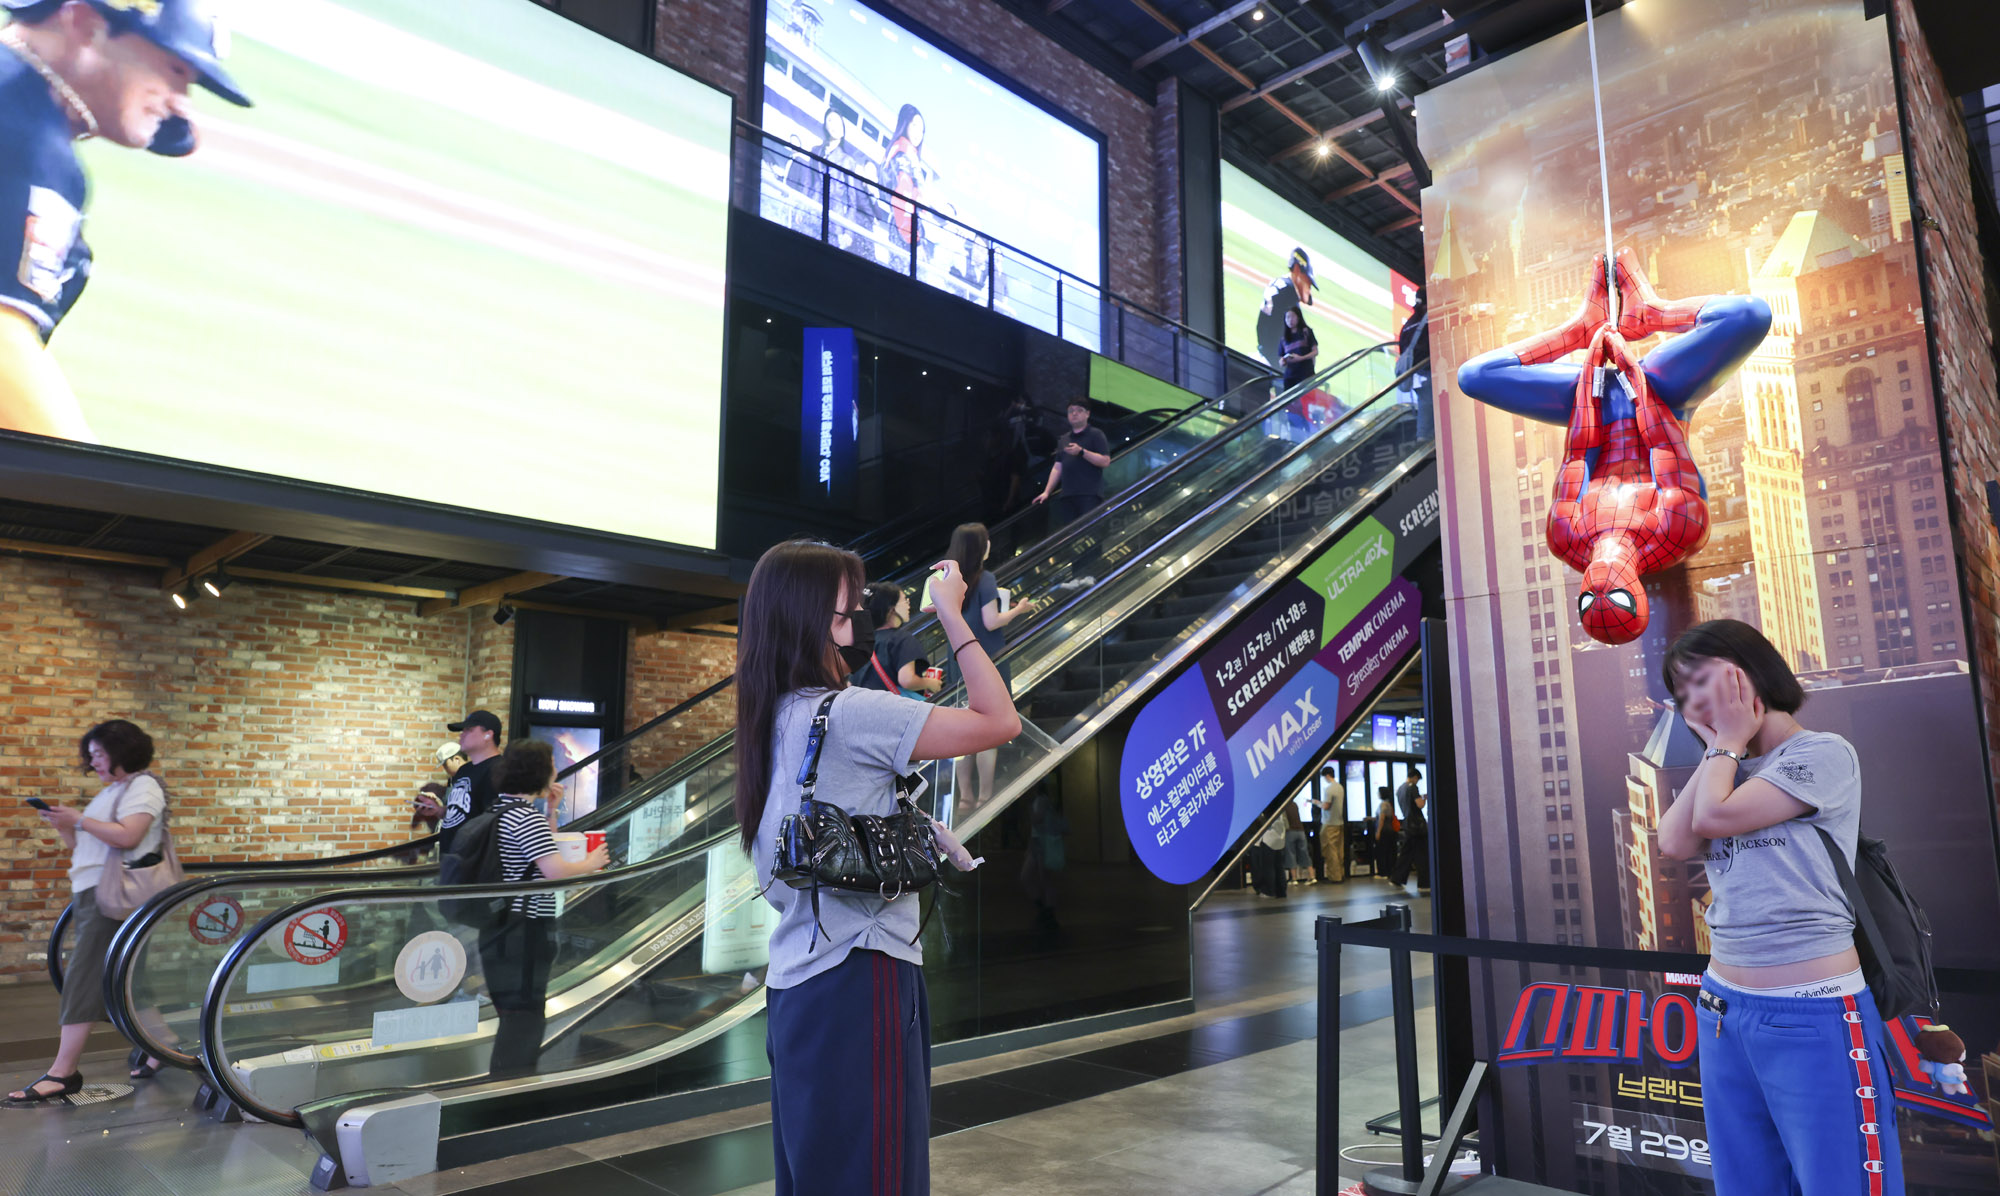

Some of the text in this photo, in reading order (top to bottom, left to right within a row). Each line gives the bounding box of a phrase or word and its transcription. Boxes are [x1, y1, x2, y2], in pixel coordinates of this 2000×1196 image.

[1399, 489, 1439, 537] SCREEN
[1327, 560, 1366, 600] ULTRA
[1364, 534, 1389, 568] 4DX
[1216, 656, 1243, 688] 1-2관
[1246, 630, 1273, 660] 5-7관
[1275, 600, 1307, 635] 11-18관
[1337, 591, 1406, 664] TEMPUR CINEMA
[1347, 624, 1410, 696] Stressless CINEMA
[1227, 651, 1286, 717] SCREENX
[1135, 719, 1207, 800] 상영관은 7F
[1245, 686, 1320, 780] IMAX
[1288, 715, 1324, 757] with Laser
[1147, 751, 1218, 827] 에스컬레이터를
[1156, 773, 1225, 847] 타고 올라가세요
[1735, 837, 1786, 855] JACKSON
[1665, 972, 1702, 986] MARVEL
[1583, 1121, 1633, 1152] 7월
